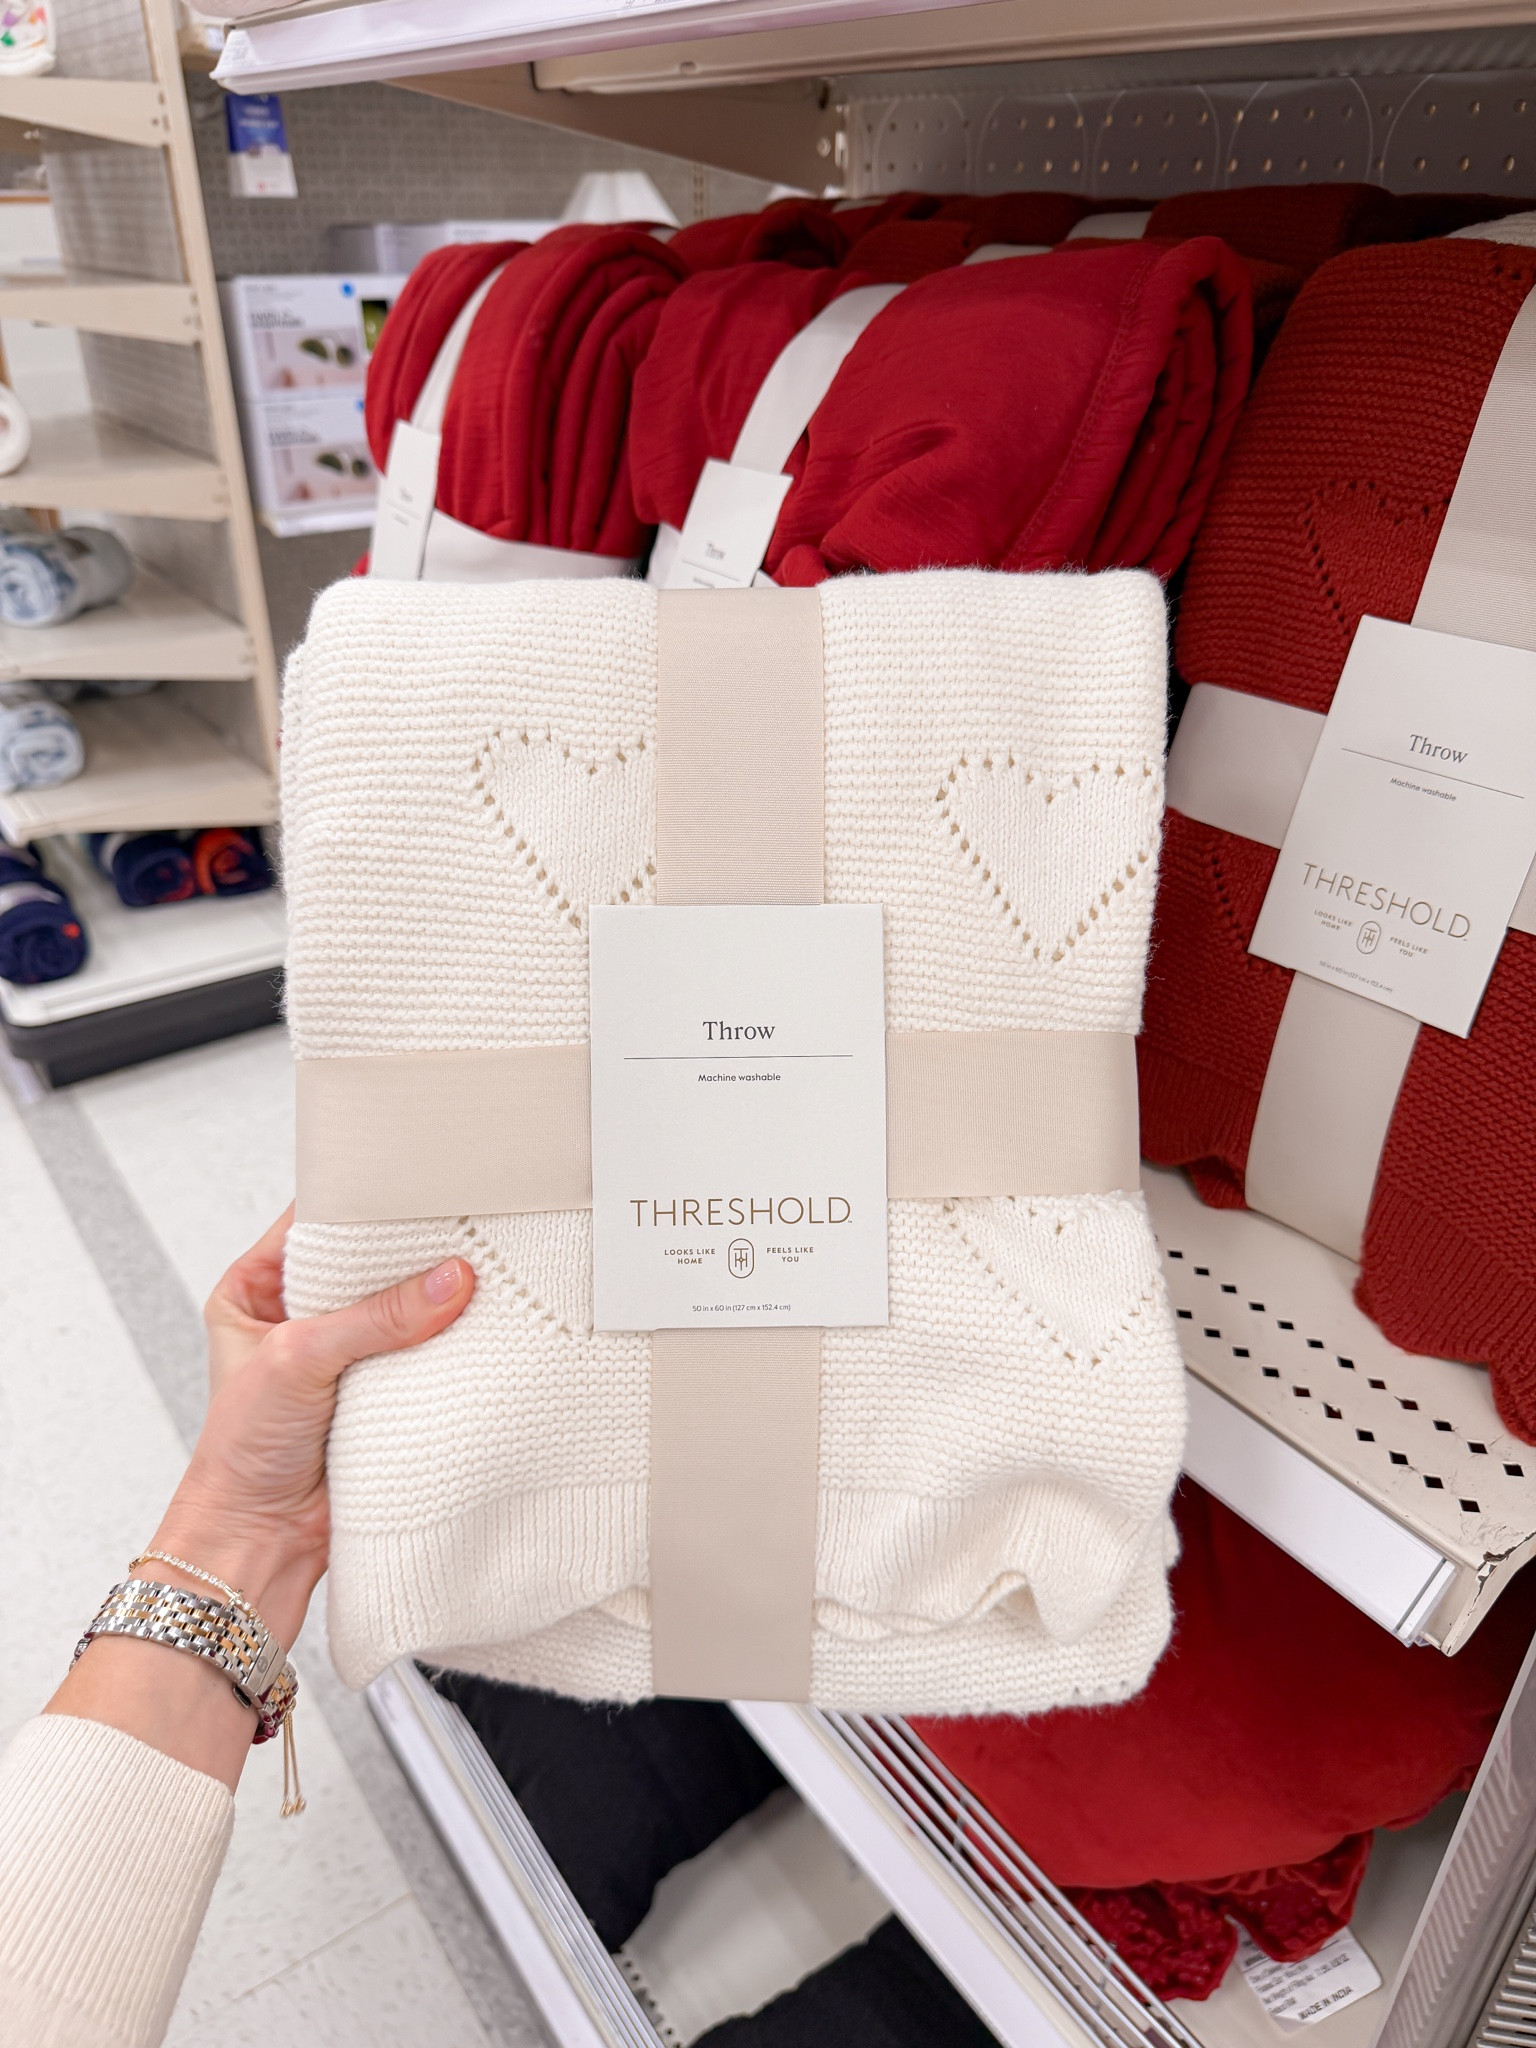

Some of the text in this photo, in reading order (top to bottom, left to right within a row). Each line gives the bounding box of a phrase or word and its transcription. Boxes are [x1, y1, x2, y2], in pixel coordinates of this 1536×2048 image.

[1409, 733, 1468, 763] Throw
[1389, 777, 1457, 802] Machine washable
[1302, 862, 1471, 939] THRESHOLD
[1313, 908, 1354, 927] LOOKS LIKE
[1320, 919, 1341, 931] HOME
[1389, 936, 1429, 955] FEELS LIKE
[1399, 947, 1414, 958] YOU
[702, 1020, 776, 1040] Throw
[697, 1072, 782, 1082] Machine washable
[629, 1196, 851, 1227] THRESHOLD
[664, 1248, 694, 1256] LOOKS
[766, 1246, 792, 1254] FEELS
[677, 1257, 703, 1265] HOME
[732, 1304, 746, 1312] (127
[779, 1304, 792, 1312] cm)
[1298, 2001, 1323, 2020] MADE
[1322, 1998, 1332, 2007] IN
